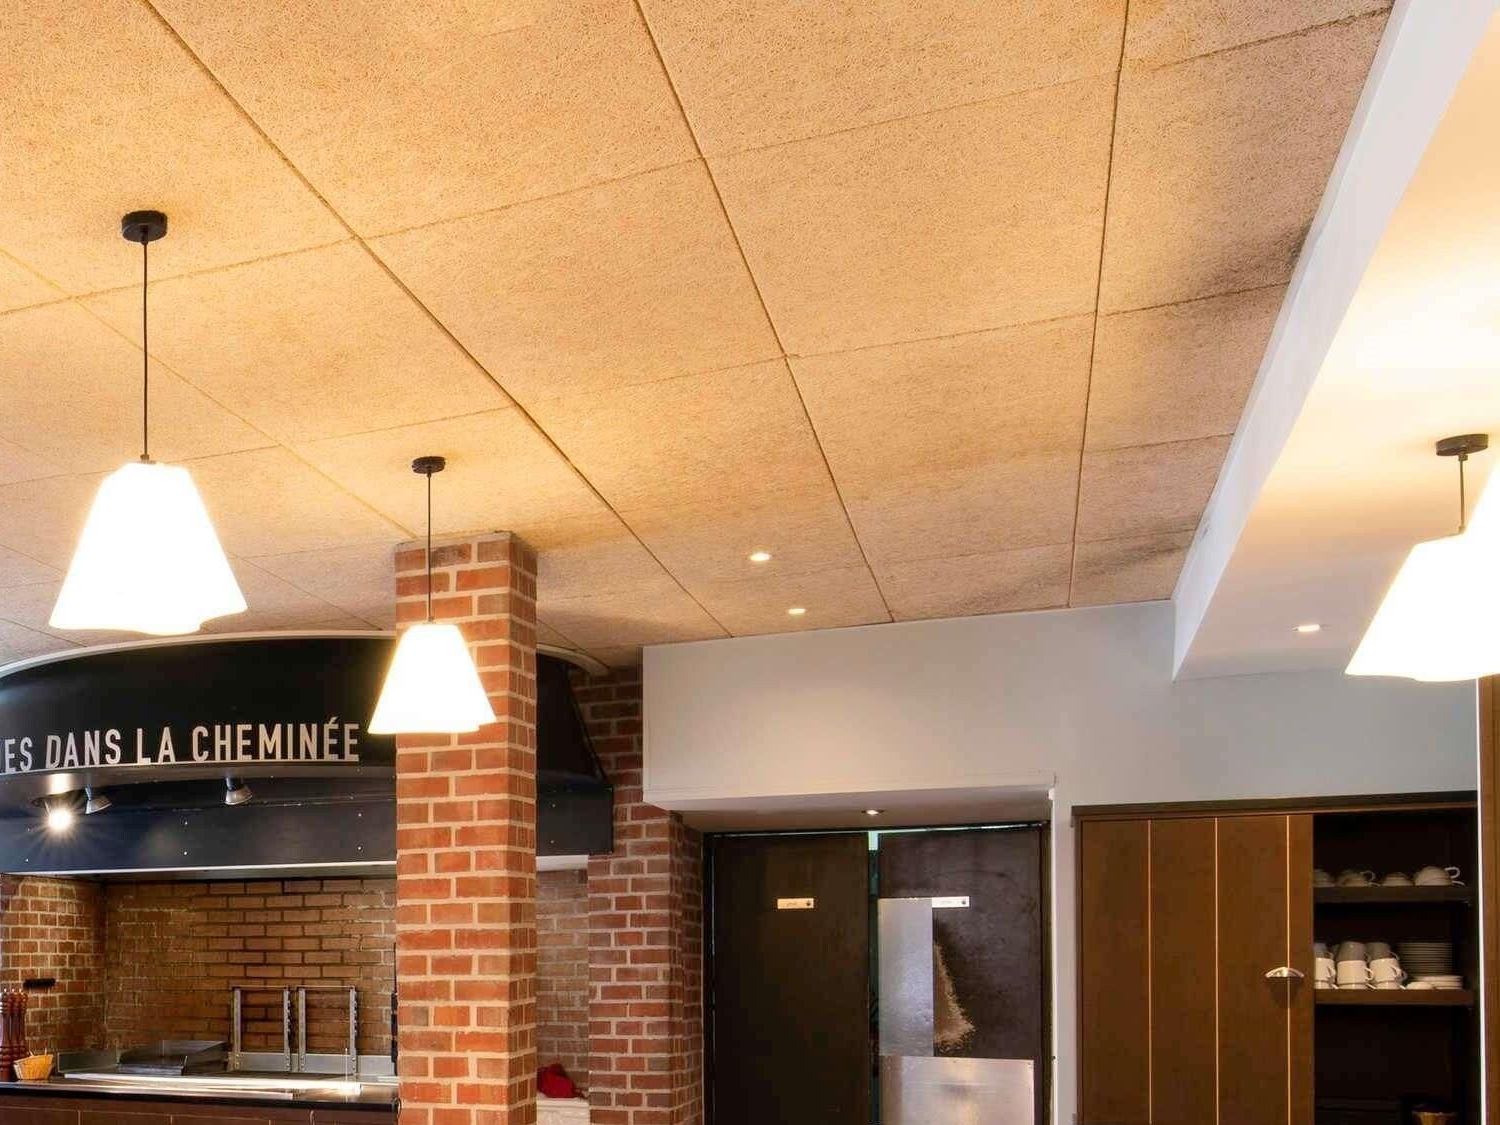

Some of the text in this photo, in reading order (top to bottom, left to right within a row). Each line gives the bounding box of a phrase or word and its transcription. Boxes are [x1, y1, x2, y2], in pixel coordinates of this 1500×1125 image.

[45, 729, 122, 769] DANS
[137, 727, 177, 765] LA
[191, 716, 360, 761] CHEMINÉE
